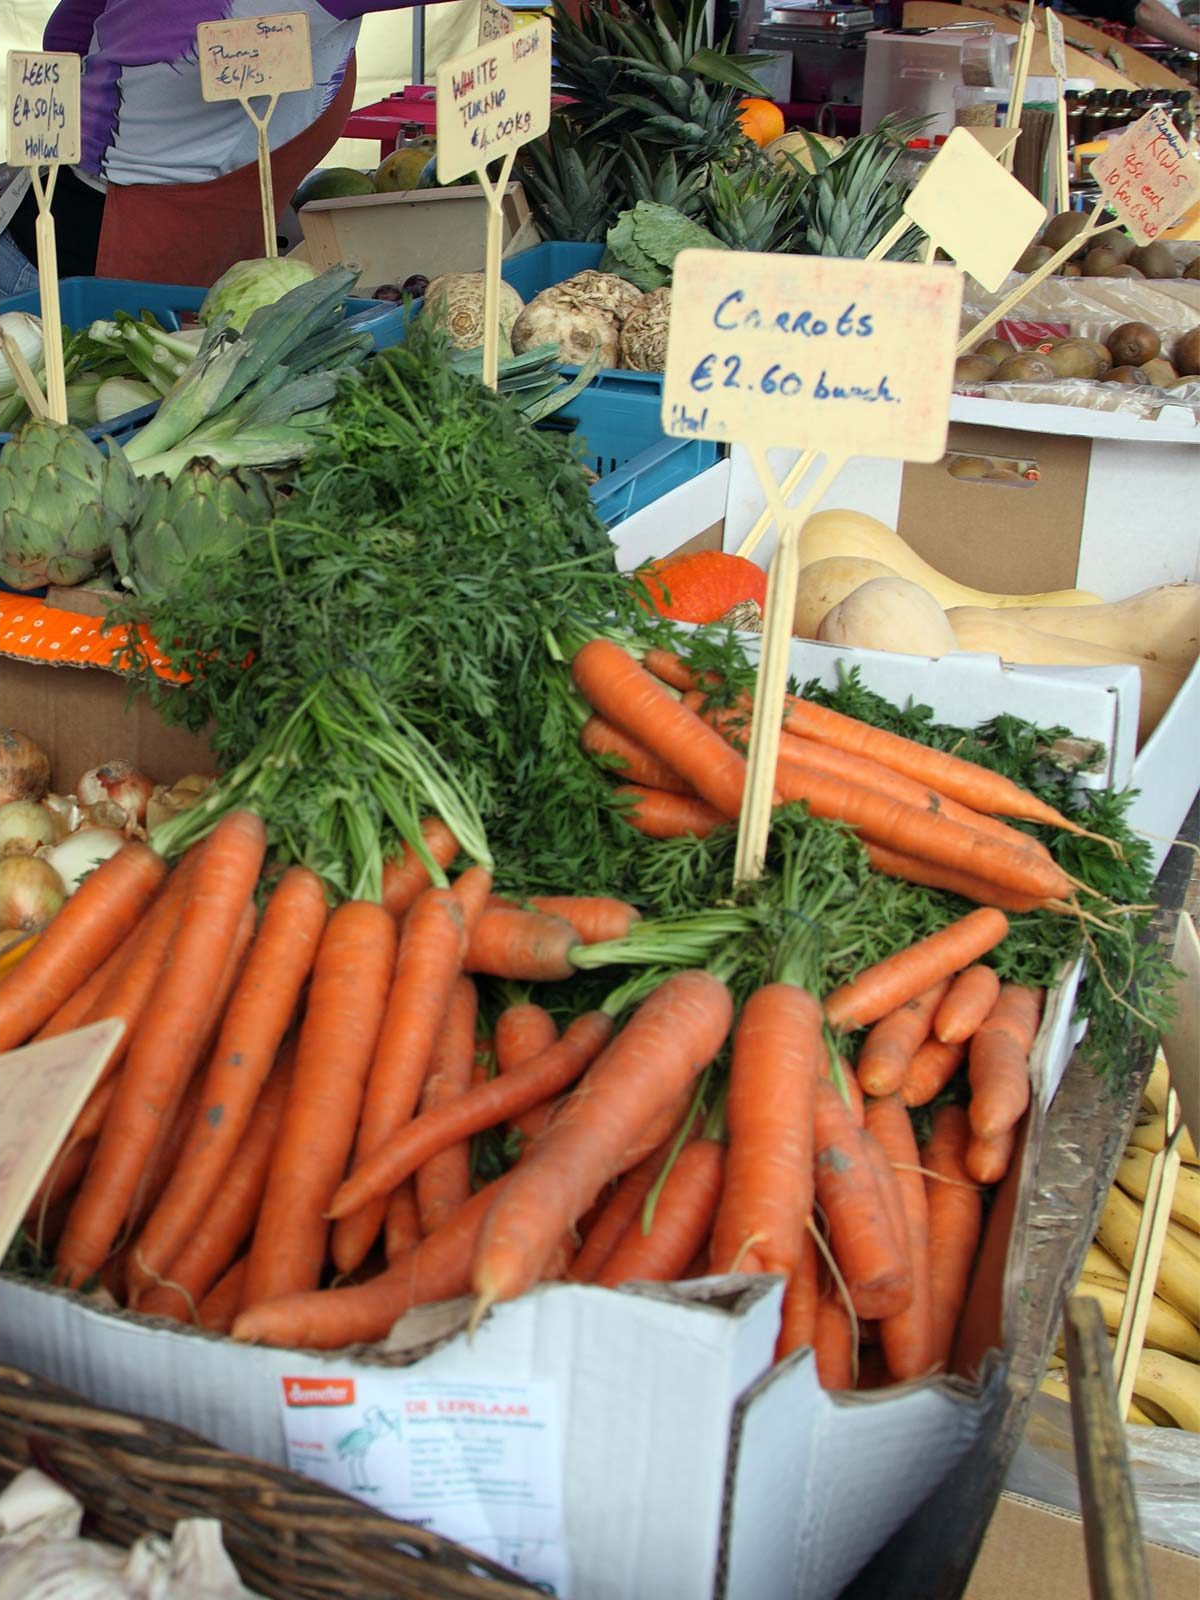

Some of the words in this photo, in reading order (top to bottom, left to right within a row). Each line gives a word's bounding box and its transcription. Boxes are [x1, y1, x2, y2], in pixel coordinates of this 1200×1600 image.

[22, 58, 59, 86] LEEKS
[452, 57, 498, 100] WHITE
[25, 133, 59, 159] Holland
[1145, 133, 1188, 188] KIWIS
[1105, 168, 1121, 186] 10
[1141, 185, 1165, 213] each
[689, 353, 803, 396] €2.60
